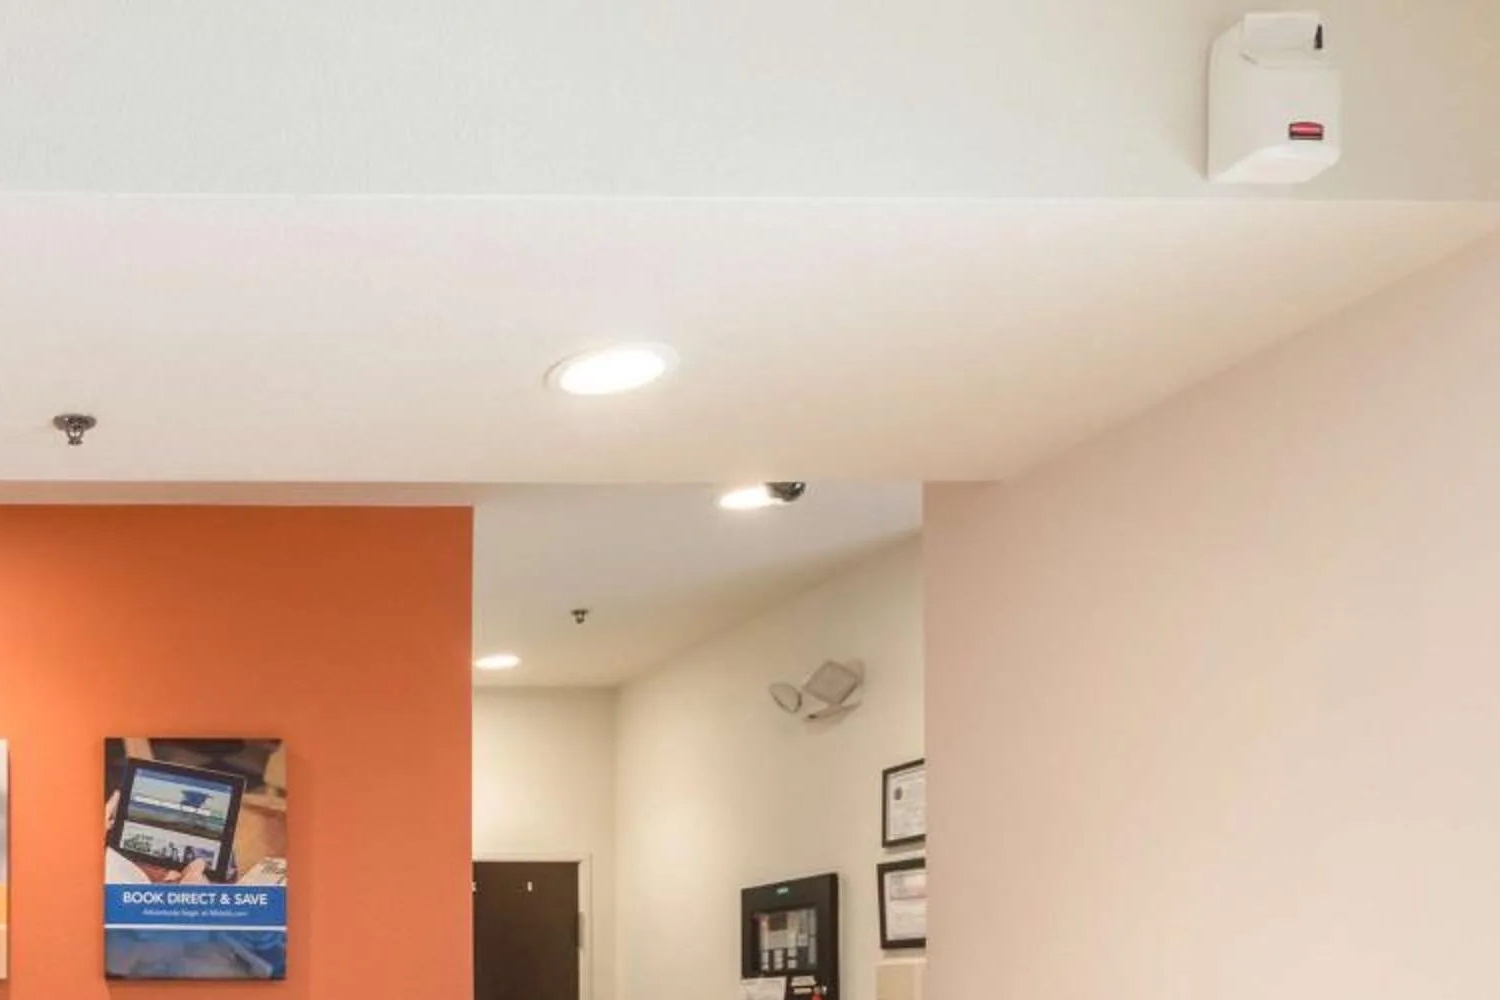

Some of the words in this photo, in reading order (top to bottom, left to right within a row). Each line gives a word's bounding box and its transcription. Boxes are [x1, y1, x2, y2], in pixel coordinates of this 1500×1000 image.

[123, 891, 164, 904] BOOK
[167, 892, 216, 904] DIRECT
[219, 893, 231, 904] &
[234, 893, 268, 905] SAVE
